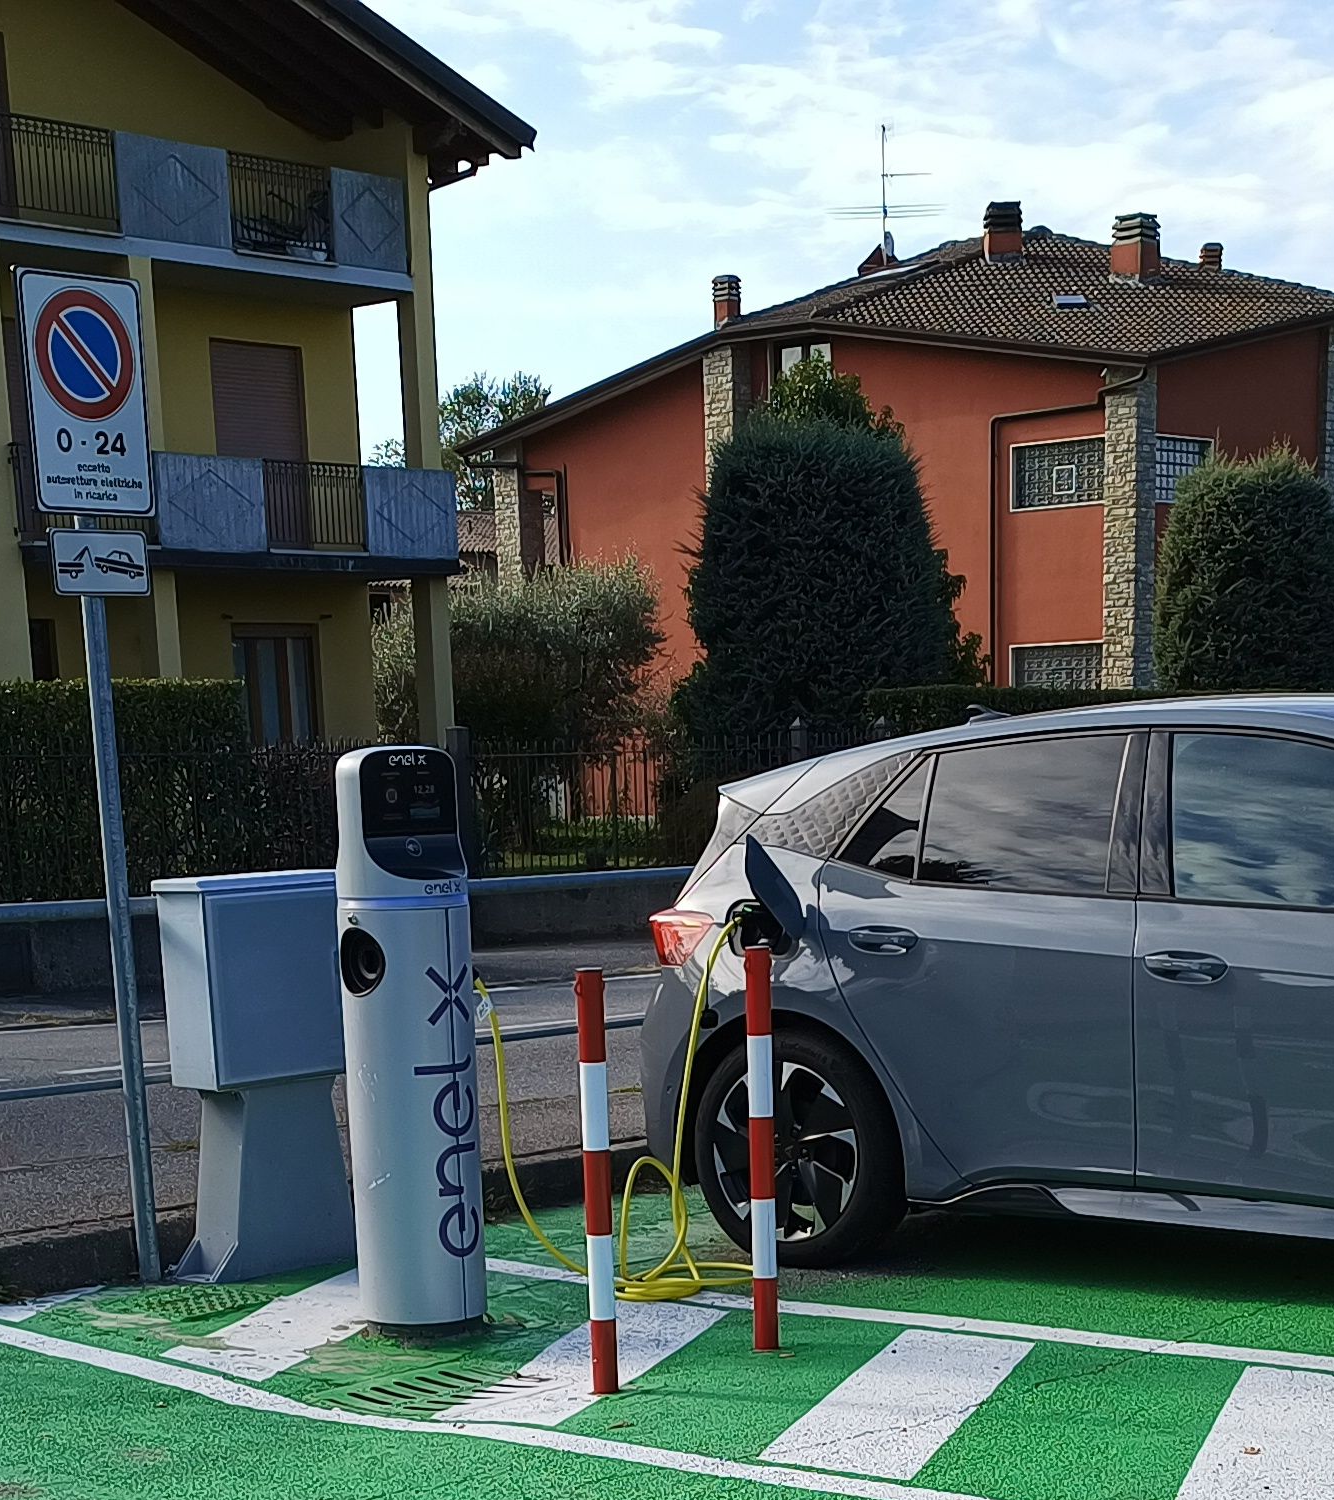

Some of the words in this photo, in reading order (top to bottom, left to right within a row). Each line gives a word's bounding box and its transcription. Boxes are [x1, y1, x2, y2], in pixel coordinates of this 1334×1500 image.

[56, 427, 73, 453] 0
[94, 430, 127, 457] 24
[76, 463, 111, 474] eccetto
[73, 488, 84, 500] in
[85, 490, 119, 502] ricarica
[388, 752, 416, 766] enel
[413, 784, 436, 795] 1228
[424, 880, 453, 895] enel
[413, 1053, 480, 1258] enel
